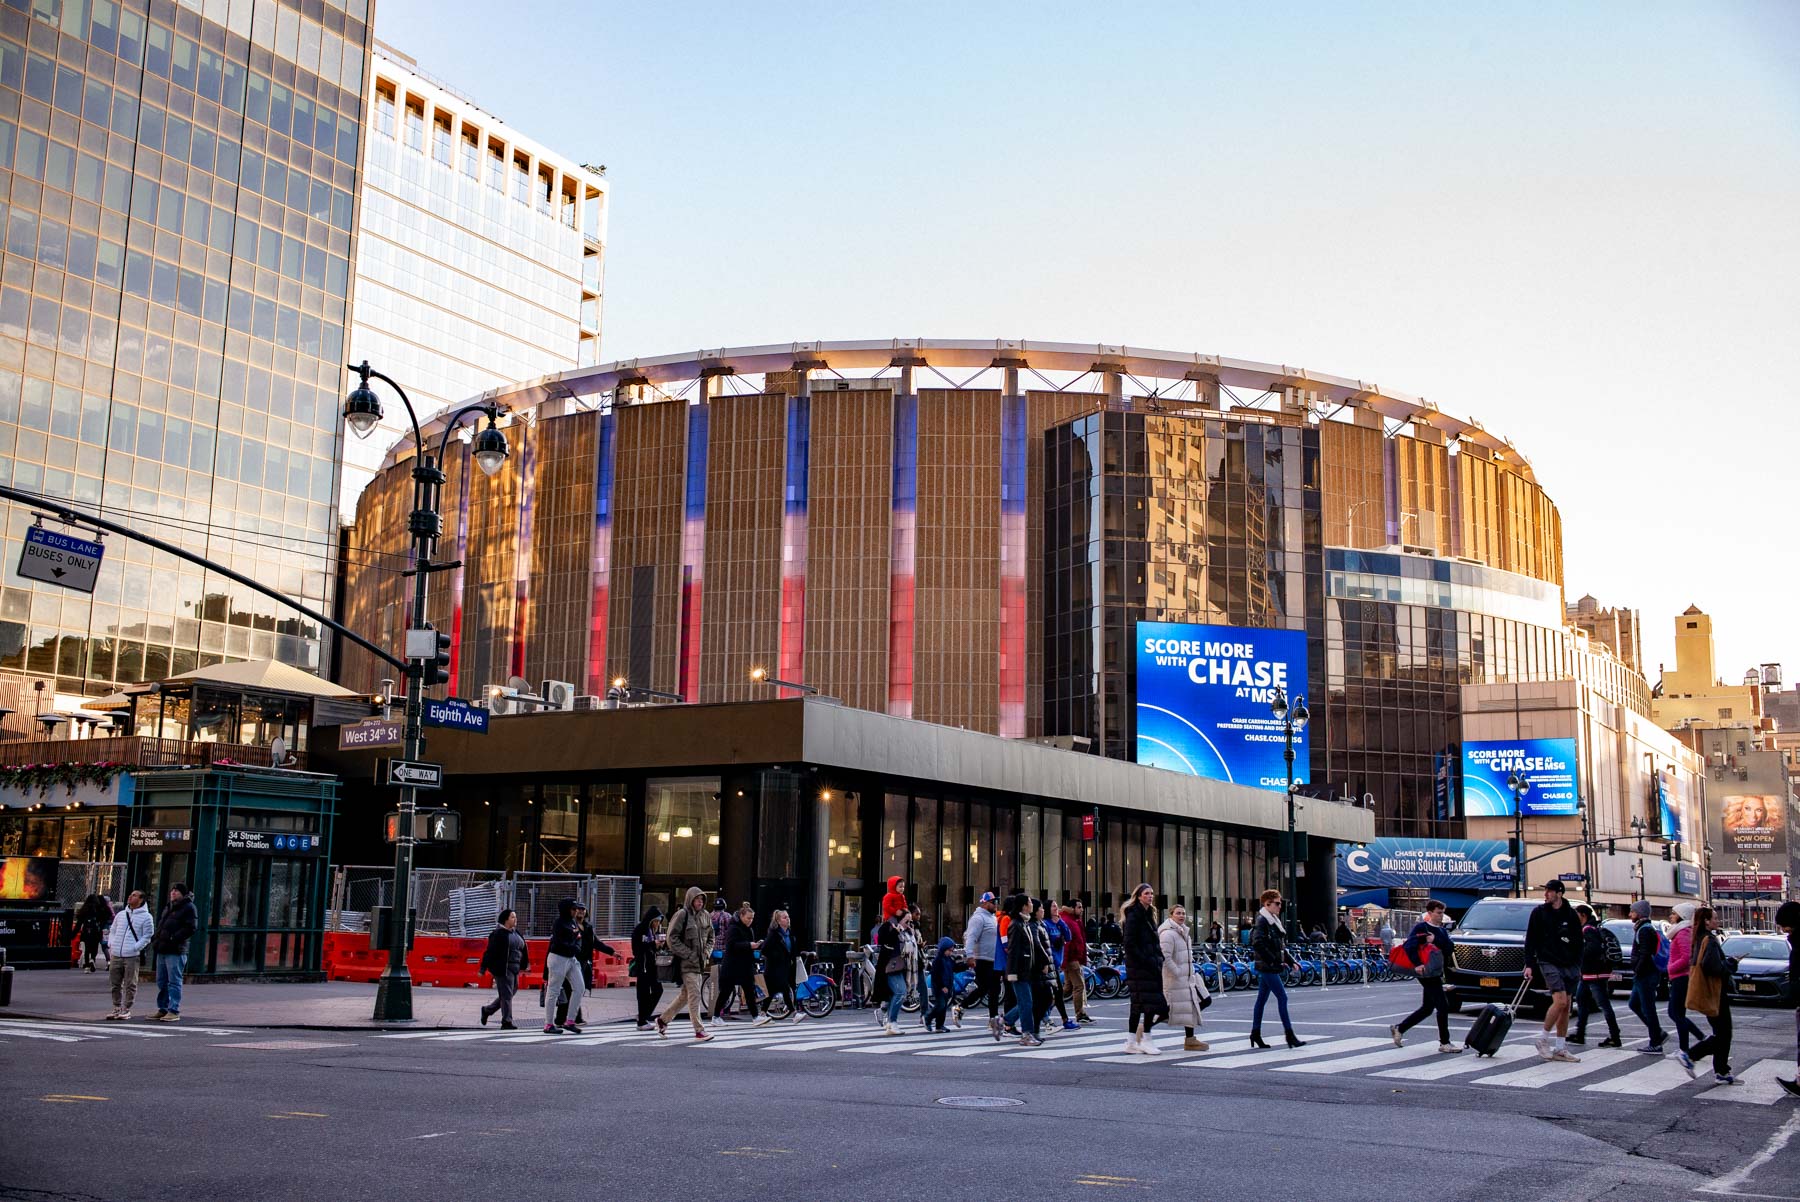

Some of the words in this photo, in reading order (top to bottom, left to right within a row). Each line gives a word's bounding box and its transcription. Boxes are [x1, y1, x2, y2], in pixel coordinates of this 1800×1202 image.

[48, 536, 68, 546] BUS
[70, 542, 98, 554] LANE
[28, 546, 63, 562] BUSES
[68, 556, 94, 570] ONLY
[1145, 639, 1200, 656] SCORE
[1204, 642, 1254, 658] MORE
[1156, 656, 1186, 666] WITH
[1188, 658, 1287, 688] CHASE
[1236, 688, 1250, 698] AT
[430, 706, 462, 722] Eighth
[464, 712, 482, 726] Ave
[346, 730, 367, 743] West
[369, 727, 385, 742] 34th
[388, 728, 397, 740] St
[1468, 750, 1496, 758] SCORE
[1490, 758, 1544, 771] CHASE
[1545, 762, 1566, 770] MSG
[399, 768, 412, 777] ONE
[418, 771, 433, 780] WAY
[1260, 778, 1288, 786] CHAS
[277, 838, 282, 846] A
[289, 839, 295, 847] C
[1347, 850, 1369, 872] C
[1382, 858, 1416, 871] MADISON
[1418, 858, 1446, 872] SQUARE
[1449, 859, 1478, 872] GARDEN
